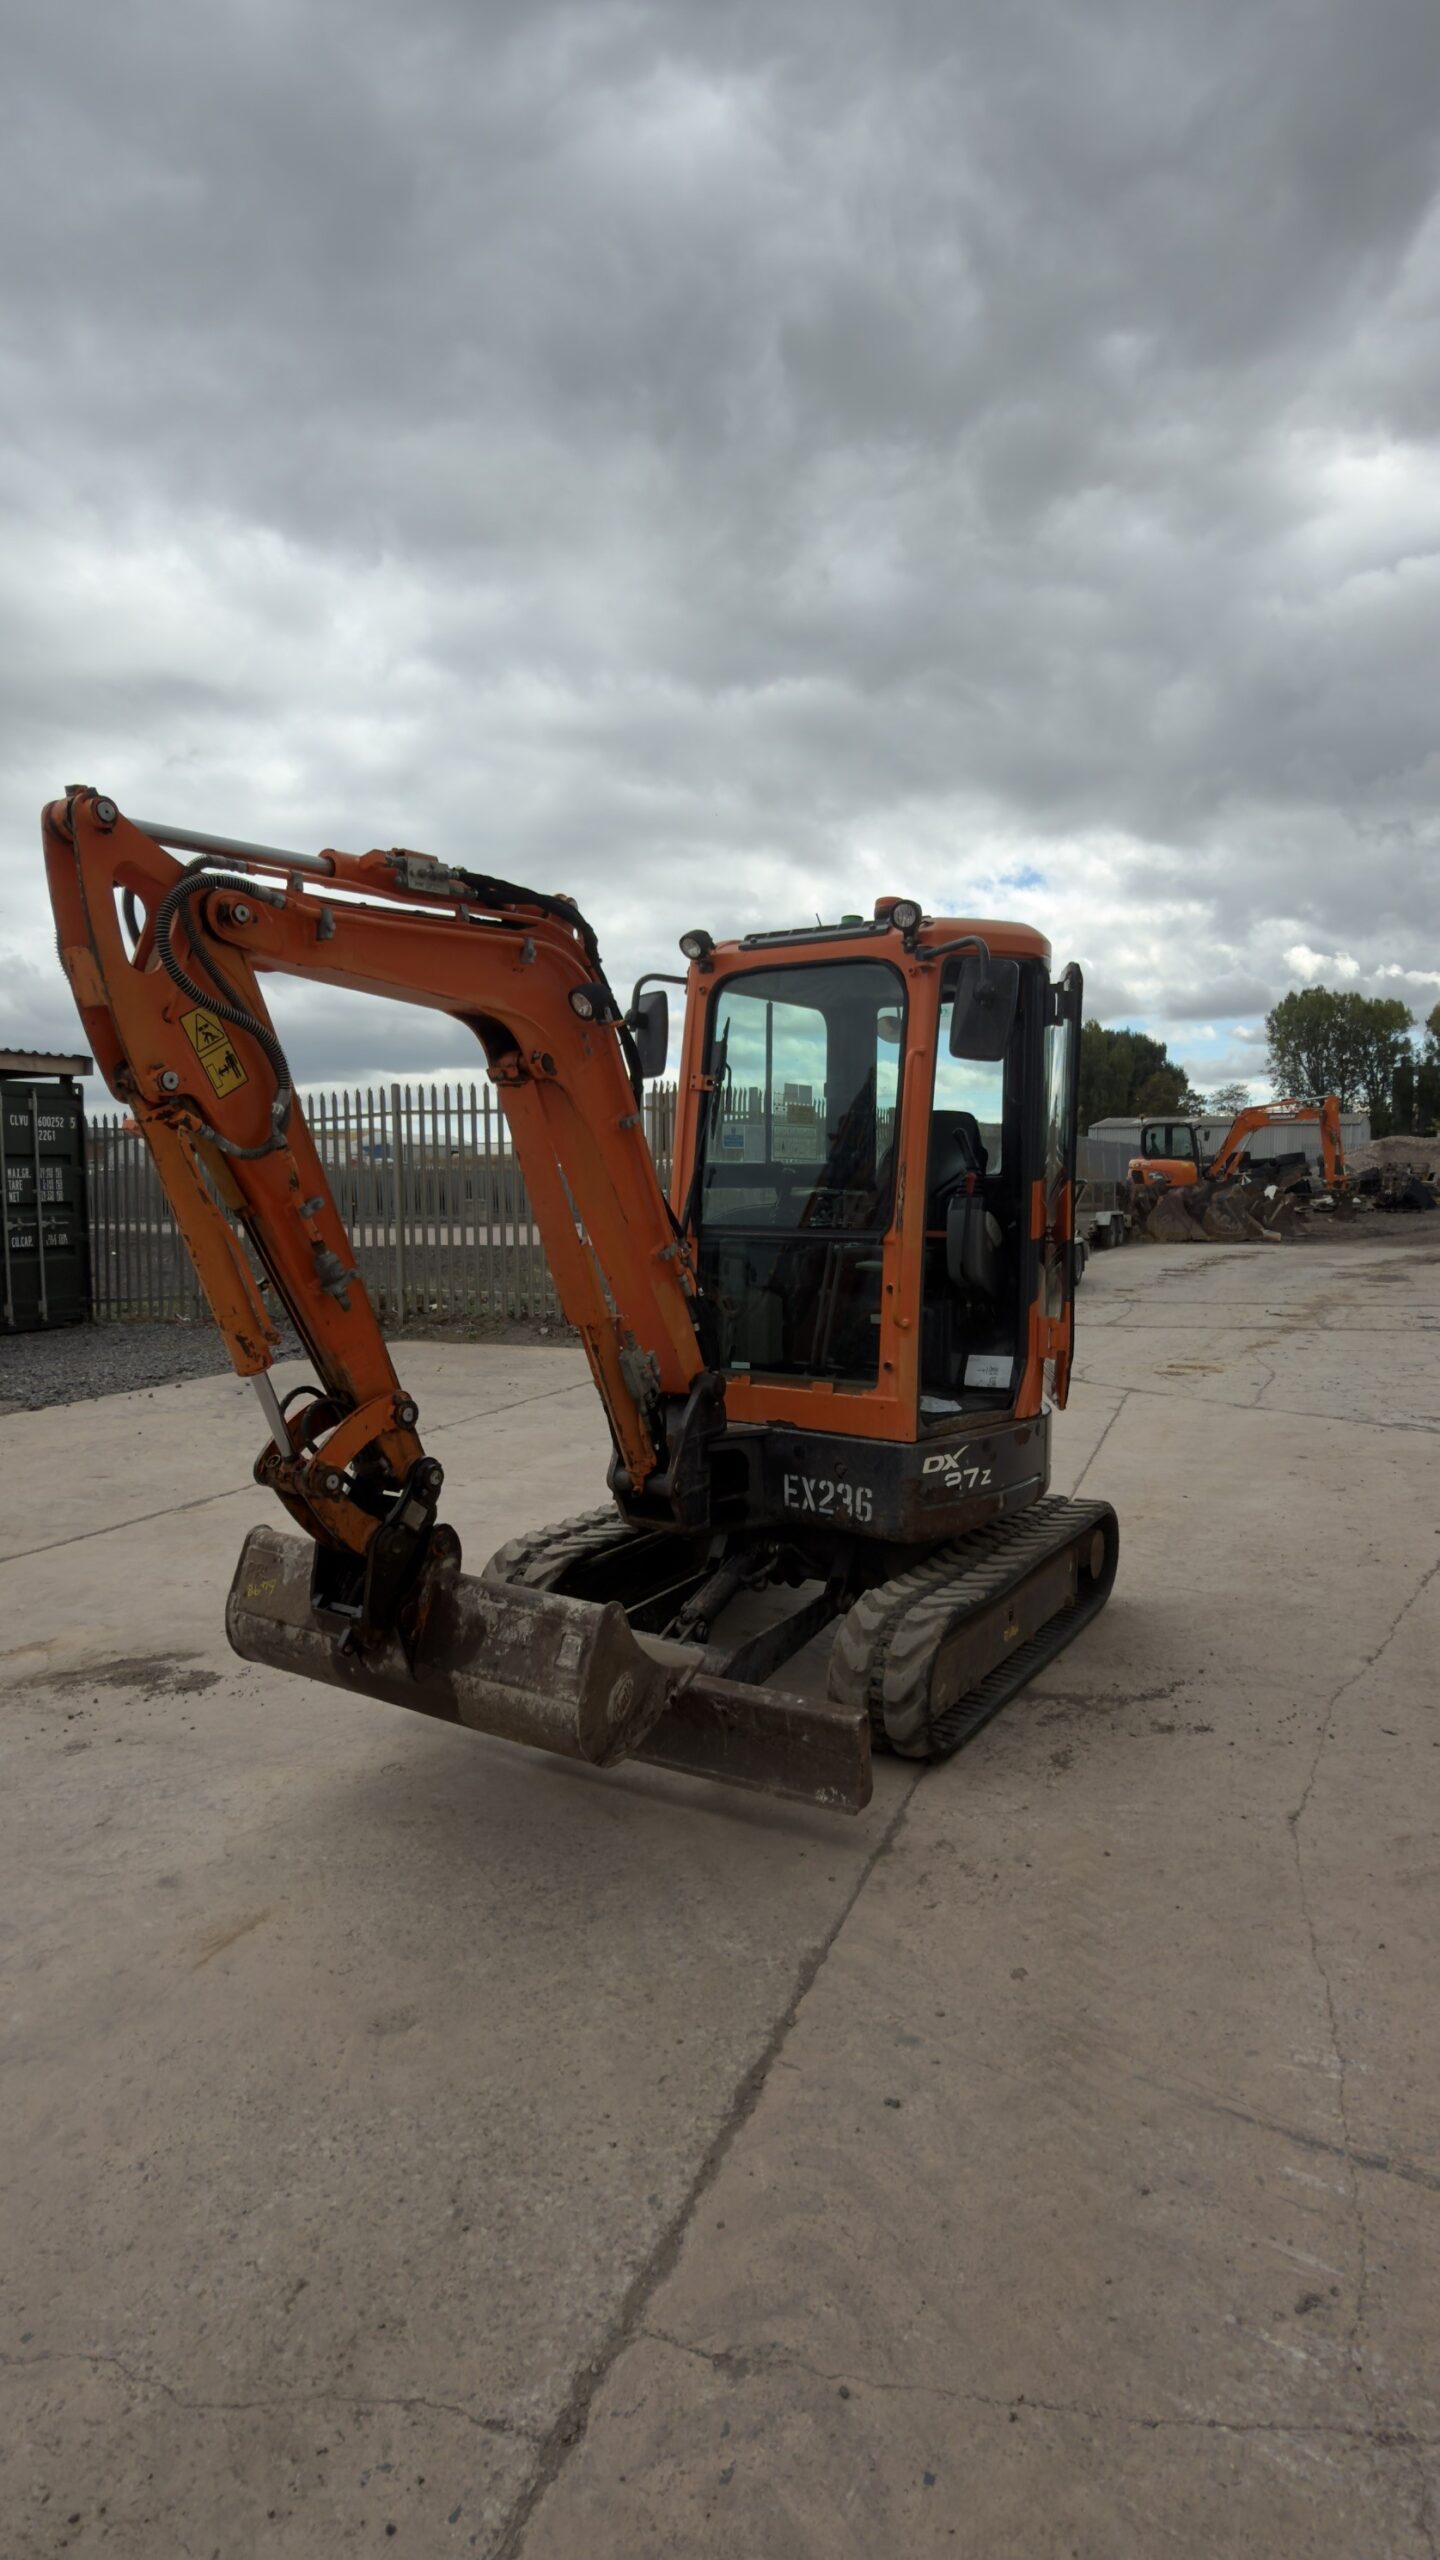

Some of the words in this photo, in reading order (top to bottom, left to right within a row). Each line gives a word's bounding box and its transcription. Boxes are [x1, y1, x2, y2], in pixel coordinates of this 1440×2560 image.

[9, 1114, 29, 1127] CLVU
[37, 1116, 65, 1128] 600252
[70, 1116, 77, 1129] 5
[38, 1129, 56, 1142] 22G1
[8, 1179, 23, 1191] TARE
[8, 1191, 20, 1203] NET
[922, 1444, 970, 1474] DX
[783, 1473, 874, 1523] EX236
